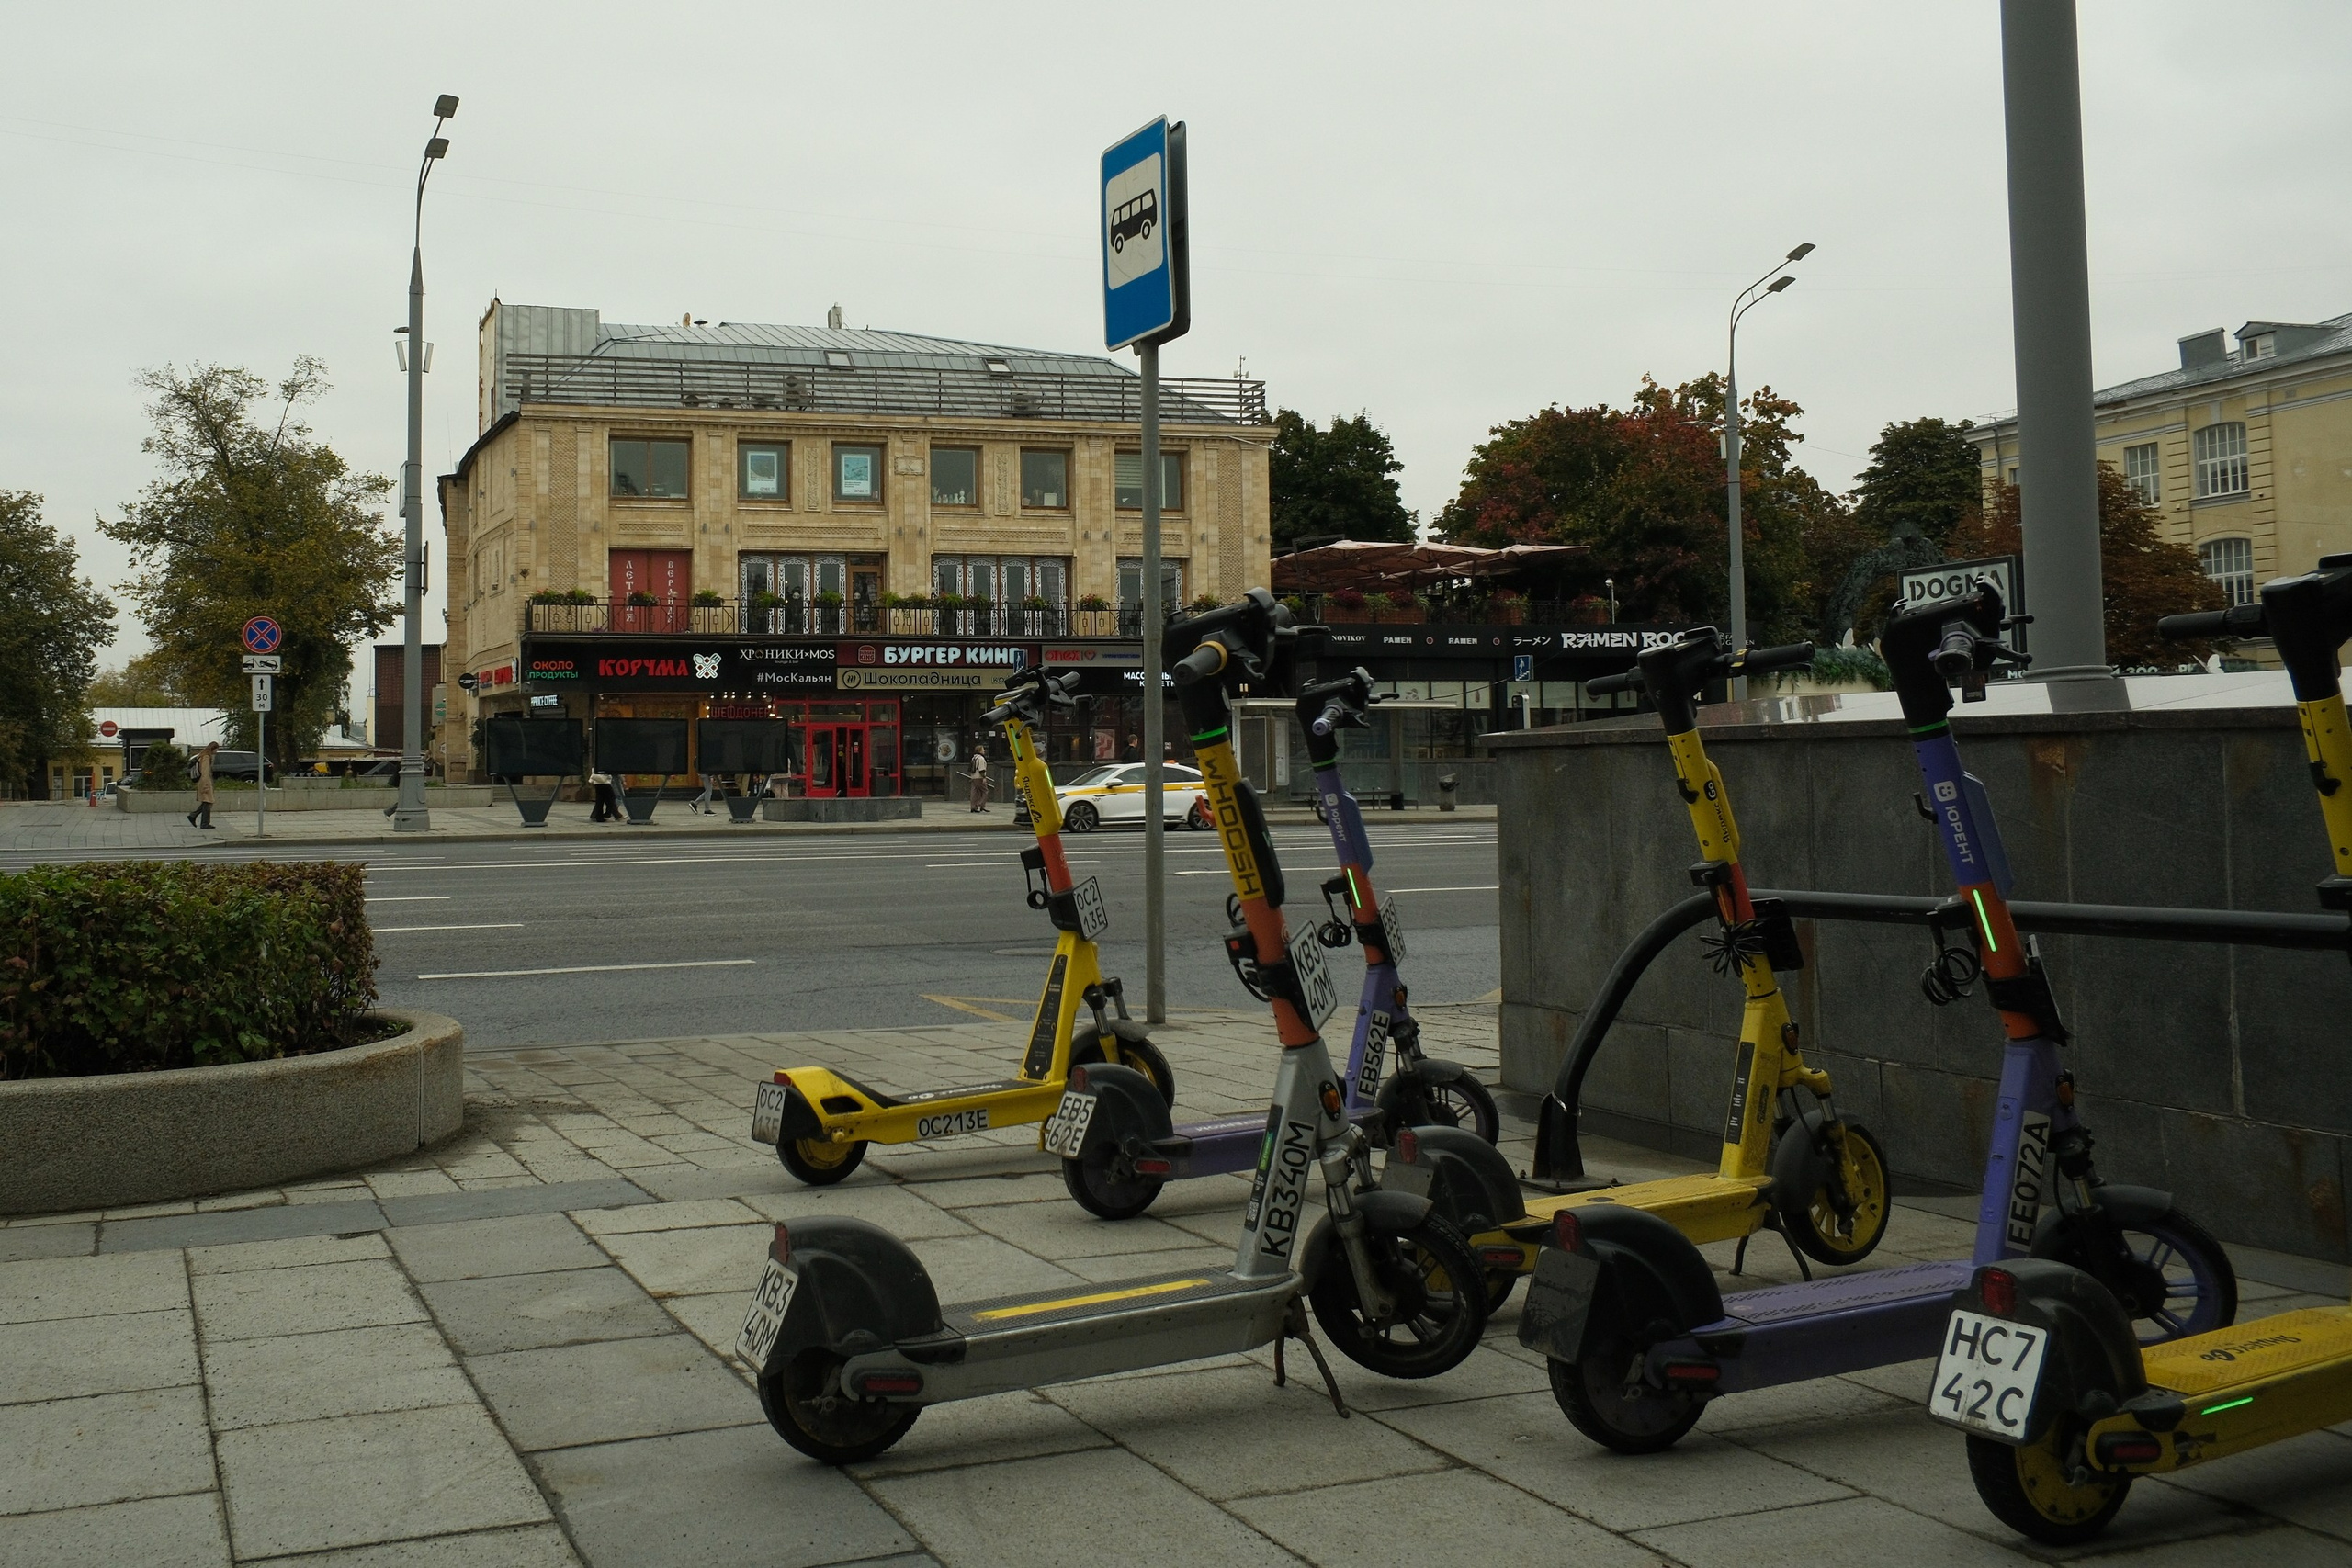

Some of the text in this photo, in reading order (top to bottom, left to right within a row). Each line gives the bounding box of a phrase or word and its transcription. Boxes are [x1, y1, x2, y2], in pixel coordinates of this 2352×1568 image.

[1513, 636, 1551, 646] ラーメン
[1561, 632, 1638, 649] RAMEN
[533, 660, 574, 671] ОКОЛО
[597, 659, 689, 677] КОРЧМА
[884, 646, 961, 664] БУРГЕР
[529, 671, 579, 680] ПРОДУКТЫ
[757, 672, 831, 682] #МосКальян
[864, 671, 981, 687] Шоколадница
[1022, 776, 1042, 824] Яндекс Go
[1707, 781, 1716, 798] Go
[1205, 759, 1261, 895] WHOOSH
[1944, 805, 1974, 864] ЮРЕНТ
[1077, 885, 1098, 910] OC2
[1084, 906, 1104, 933] 13E
[1294, 931, 1321, 983] KB3
[1308, 967, 1333, 1016] 40M
[1358, 1012, 1389, 1096] EB562E
[760, 1089, 783, 1111] OC2
[1057, 1096, 1093, 1124] EB5
[919, 1110, 988, 1137] OC213E
[1049, 1123, 1082, 1153] 62E
[1261, 1121, 1315, 1257] KB340M
[2007, 1122, 2049, 1246] EE072A
[755, 1266, 793, 1315] KB3
[744, 1310, 779, 1361] 40M
[1949, 1317, 2036, 1371] HC7
[1941, 1372, 2024, 1427] 42C
